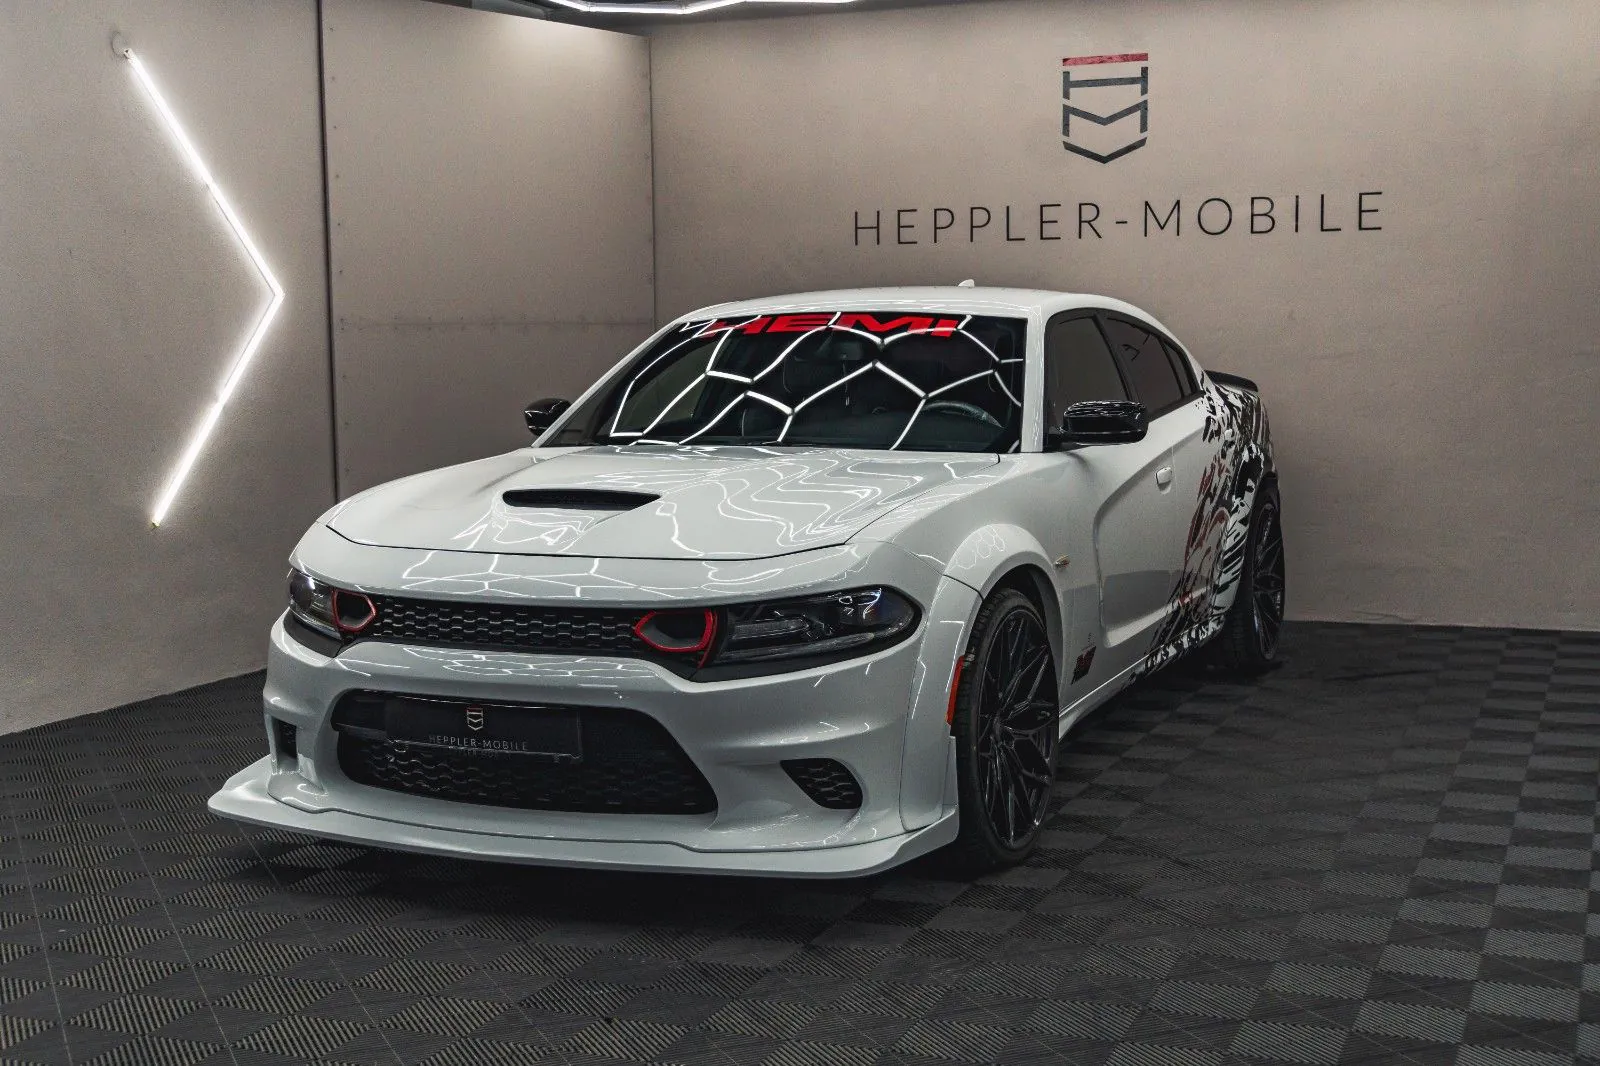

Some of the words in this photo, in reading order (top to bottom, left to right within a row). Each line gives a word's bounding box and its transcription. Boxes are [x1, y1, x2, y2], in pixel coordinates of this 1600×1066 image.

[854, 191, 1384, 247] HEPPLER-MOBILE
[699, 313, 960, 338] HEMI
[429, 735, 528, 750] HEPPLER-MOBILE
